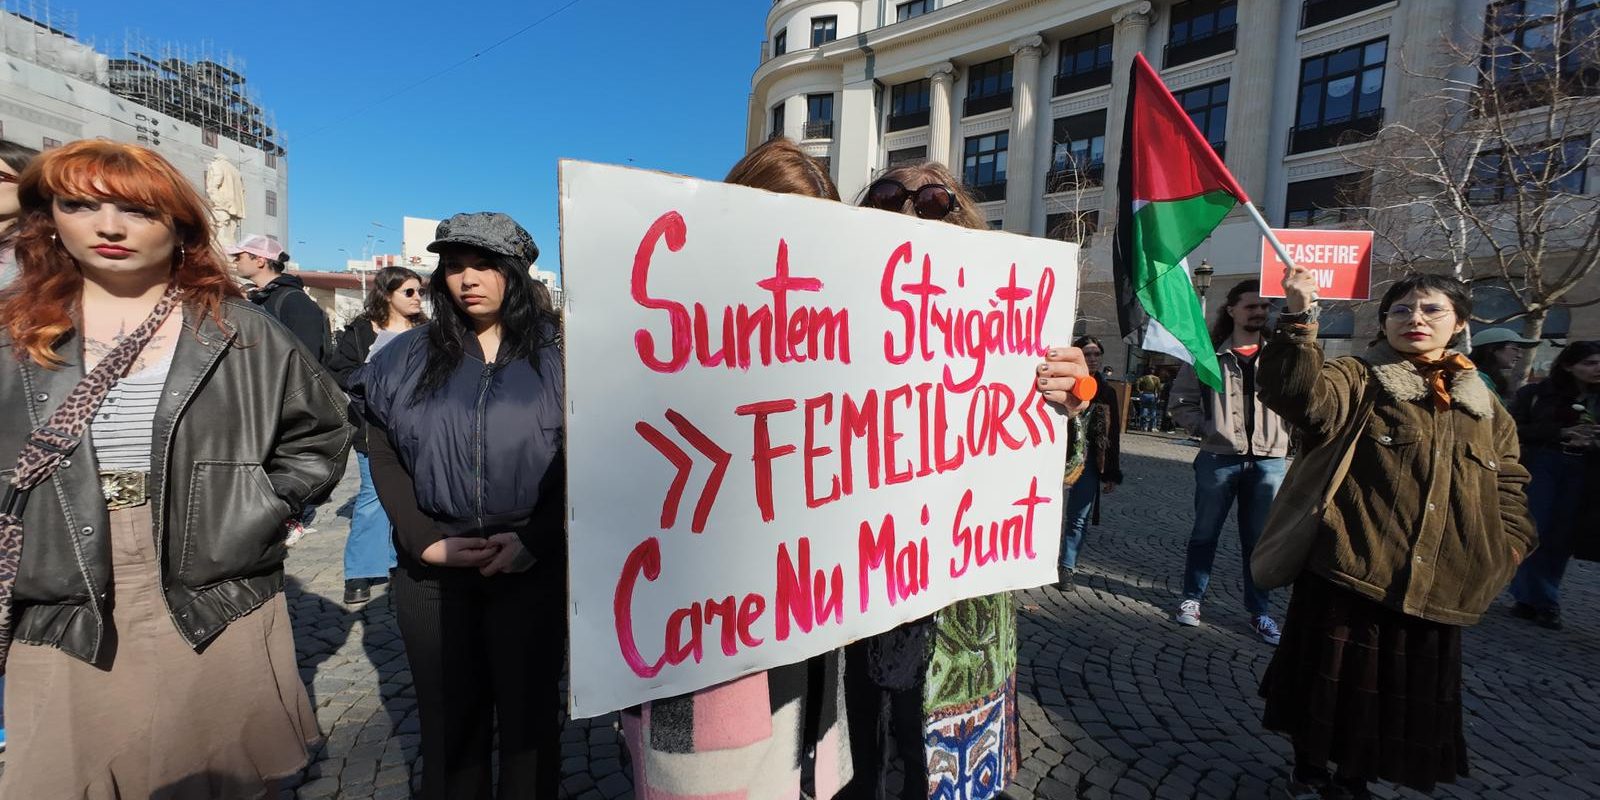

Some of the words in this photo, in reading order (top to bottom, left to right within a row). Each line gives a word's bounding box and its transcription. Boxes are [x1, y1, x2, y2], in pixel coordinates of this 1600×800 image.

[631, 211, 851, 374] Suntem
[614, 537, 766, 679] Care
[774, 536, 844, 642] Nu
[857, 504, 931, 614] Mai
[949, 476, 1052, 580] Sunt
